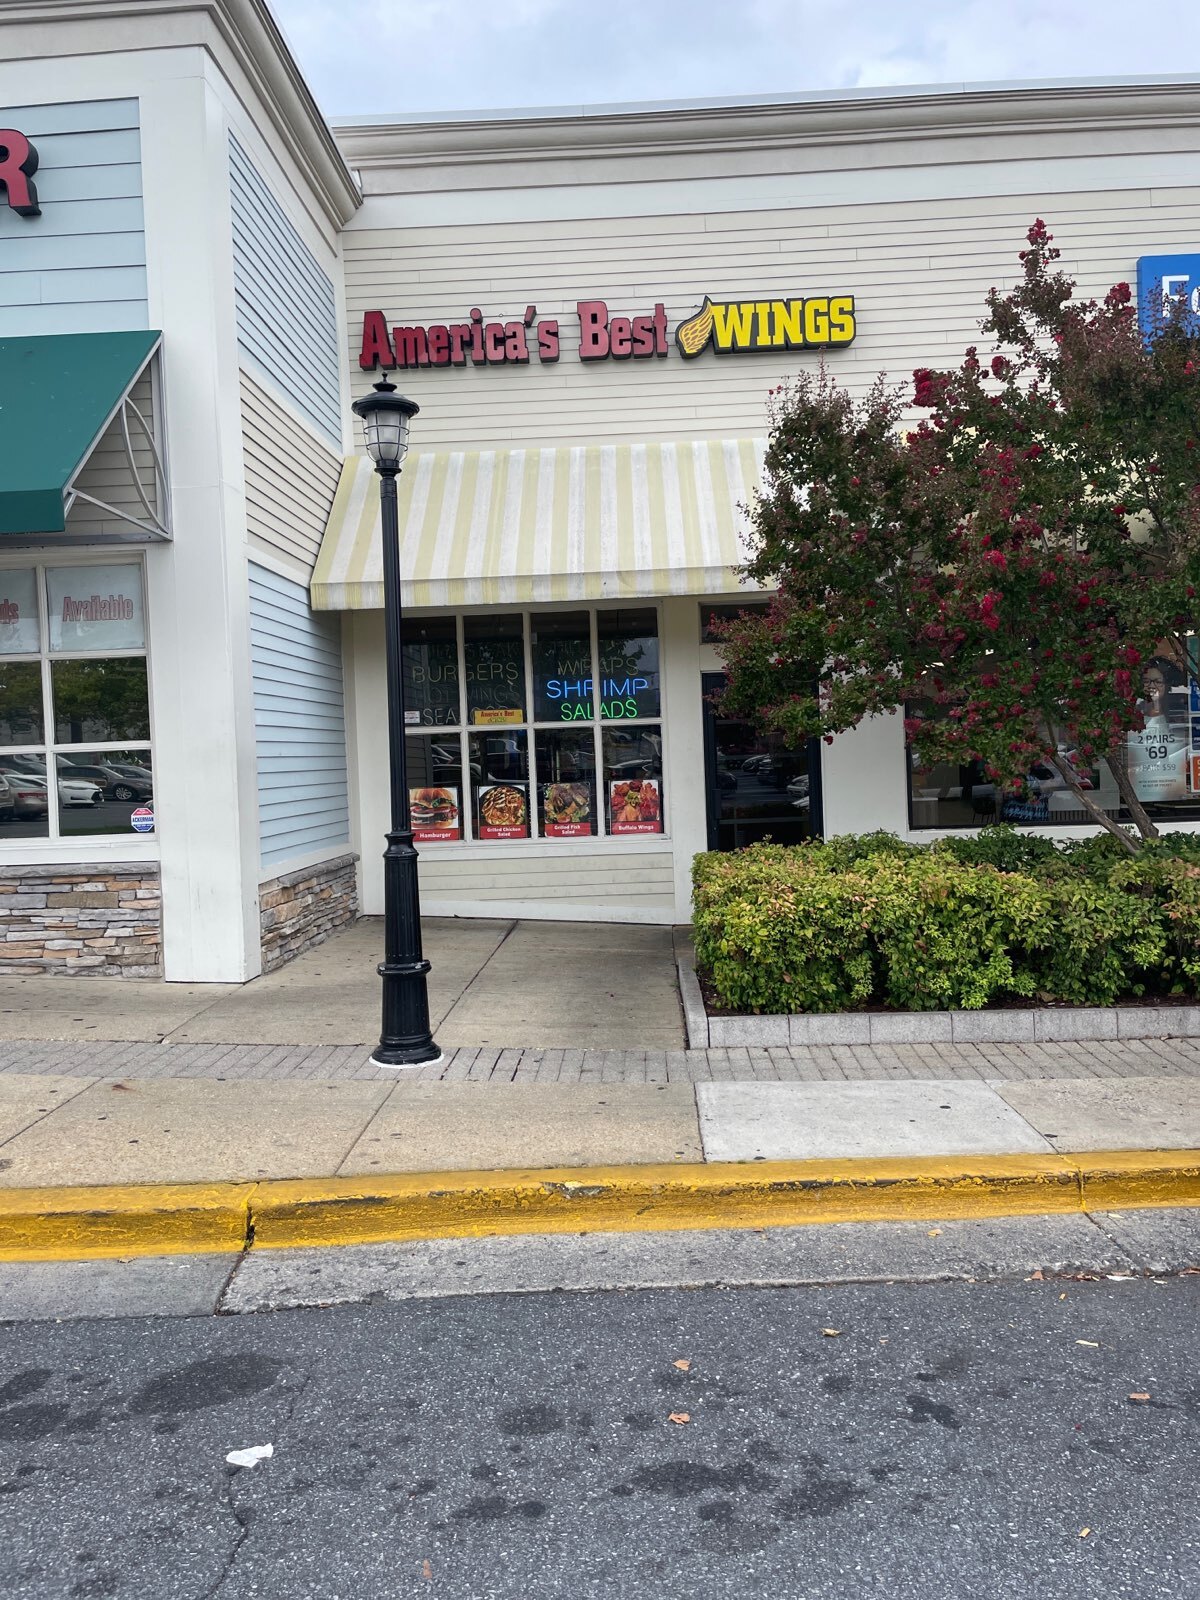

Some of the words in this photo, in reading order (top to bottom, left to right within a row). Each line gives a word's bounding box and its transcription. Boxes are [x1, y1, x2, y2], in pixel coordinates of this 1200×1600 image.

[359, 306, 559, 369] America's
[578, 301, 668, 361] Best
[711, 295, 856, 351] WINGS
[63, 594, 133, 622] Available
[412, 663, 518, 683] BURGERS
[546, 678, 648, 698] SHRIMP
[560, 700, 638, 721] SALADS
[1137, 735, 1143, 744] 2
[1146, 734, 1175, 744] PAIRS
[1162, 763, 1176, 771] $59
